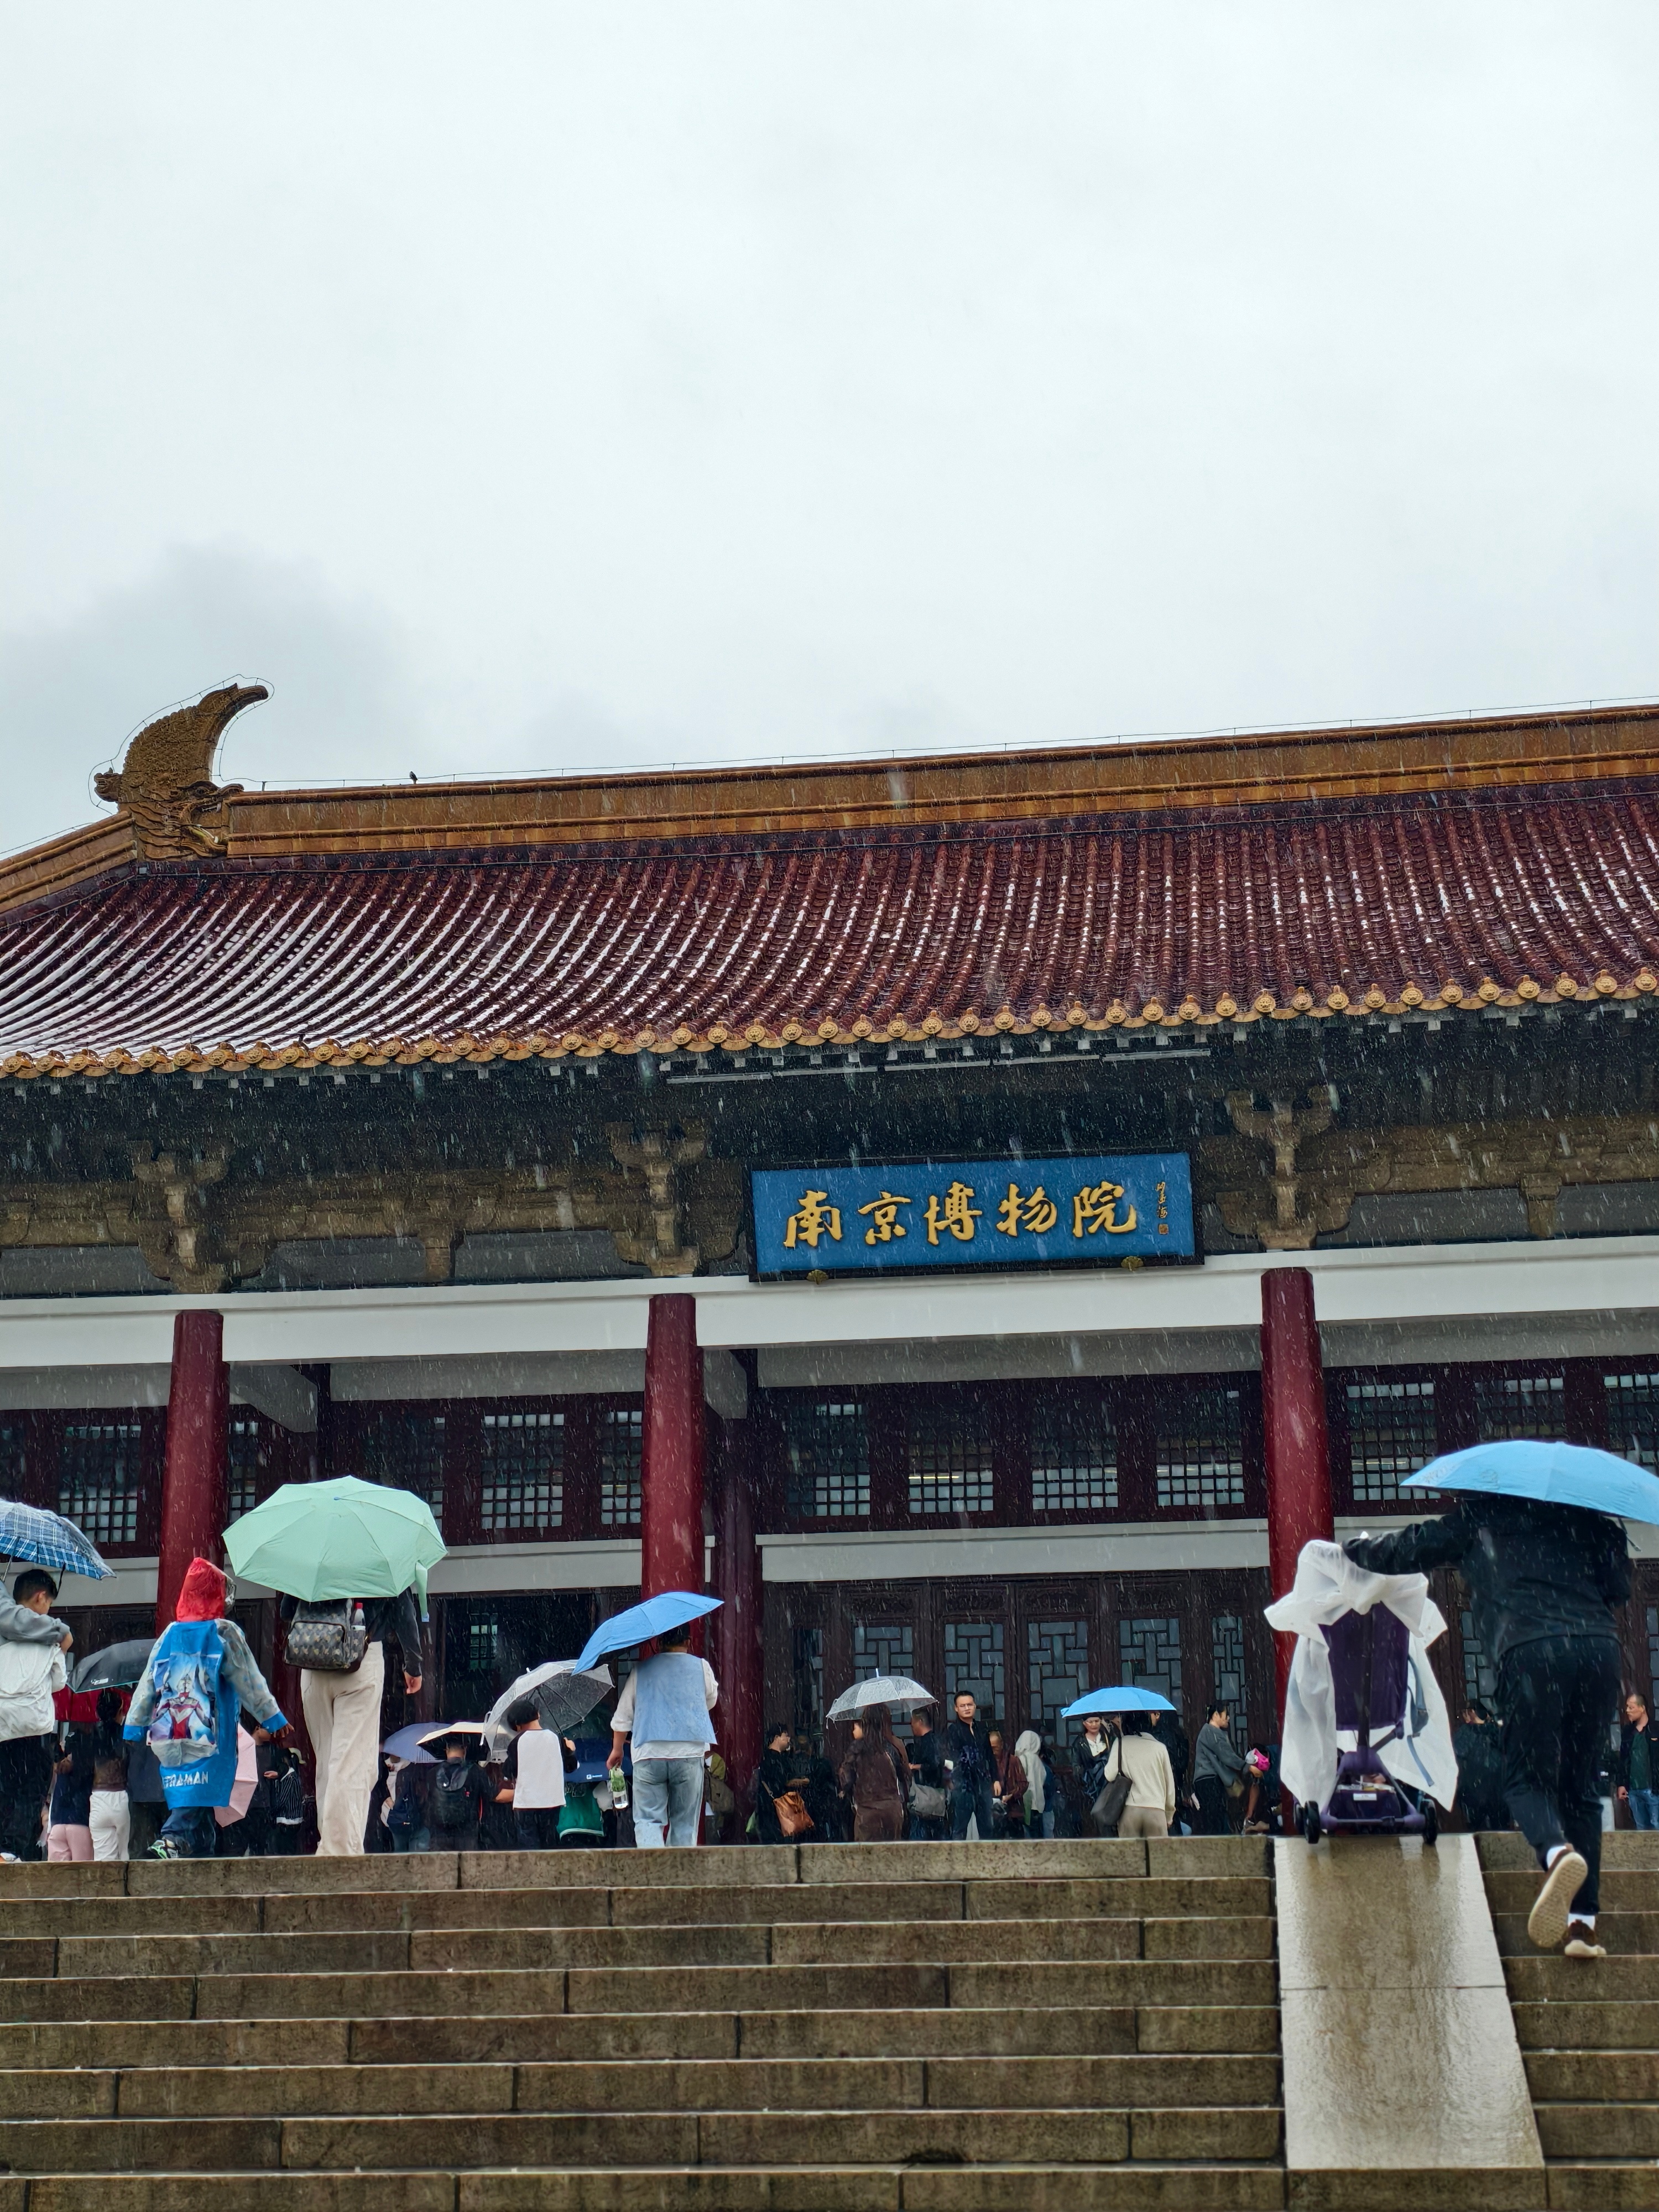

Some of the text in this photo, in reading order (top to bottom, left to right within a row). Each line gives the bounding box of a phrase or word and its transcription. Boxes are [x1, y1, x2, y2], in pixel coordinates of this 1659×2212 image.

[784, 1181, 1136, 1248] 南京博物院
